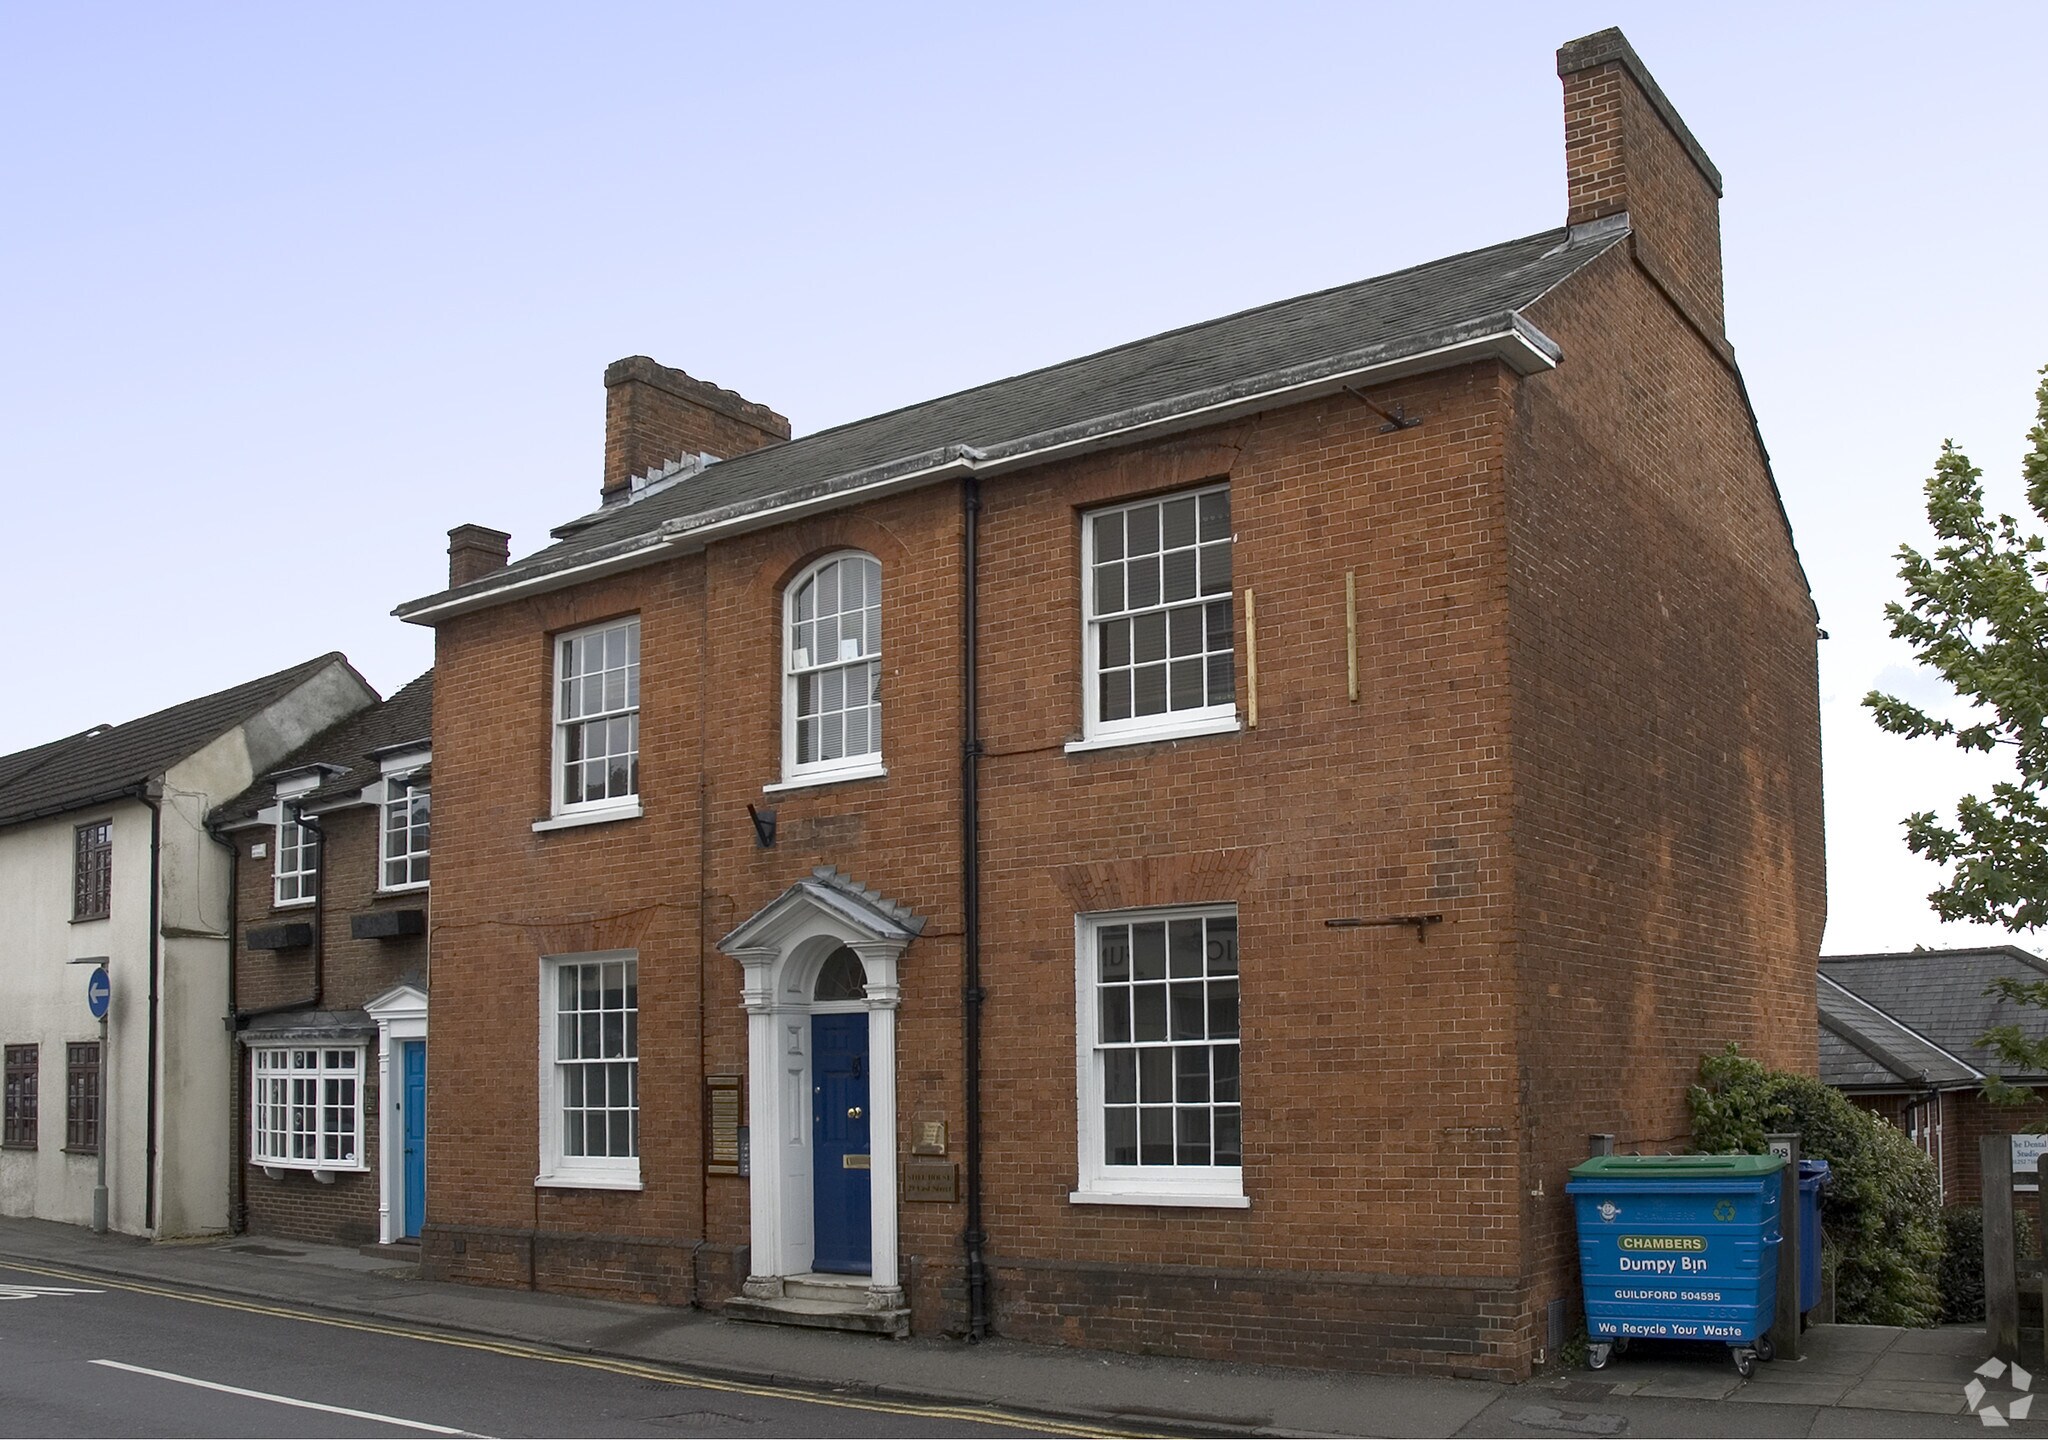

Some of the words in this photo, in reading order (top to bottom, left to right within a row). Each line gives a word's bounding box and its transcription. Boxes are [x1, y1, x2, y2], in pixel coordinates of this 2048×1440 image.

[1623, 1238, 1702, 1250] CHAMBERS
[1620, 1257, 1675, 1274] Dumpy
[1681, 1256, 1707, 1274] Bin
[1614, 1289, 1678, 1300] GUILDFORD
[1680, 1291, 1721, 1301] 504595
[1598, 1322, 1617, 1333] We
[1622, 1323, 1667, 1336] Recycle
[1671, 1324, 1698, 1335] Your
[1702, 1325, 1742, 1336] Waste
